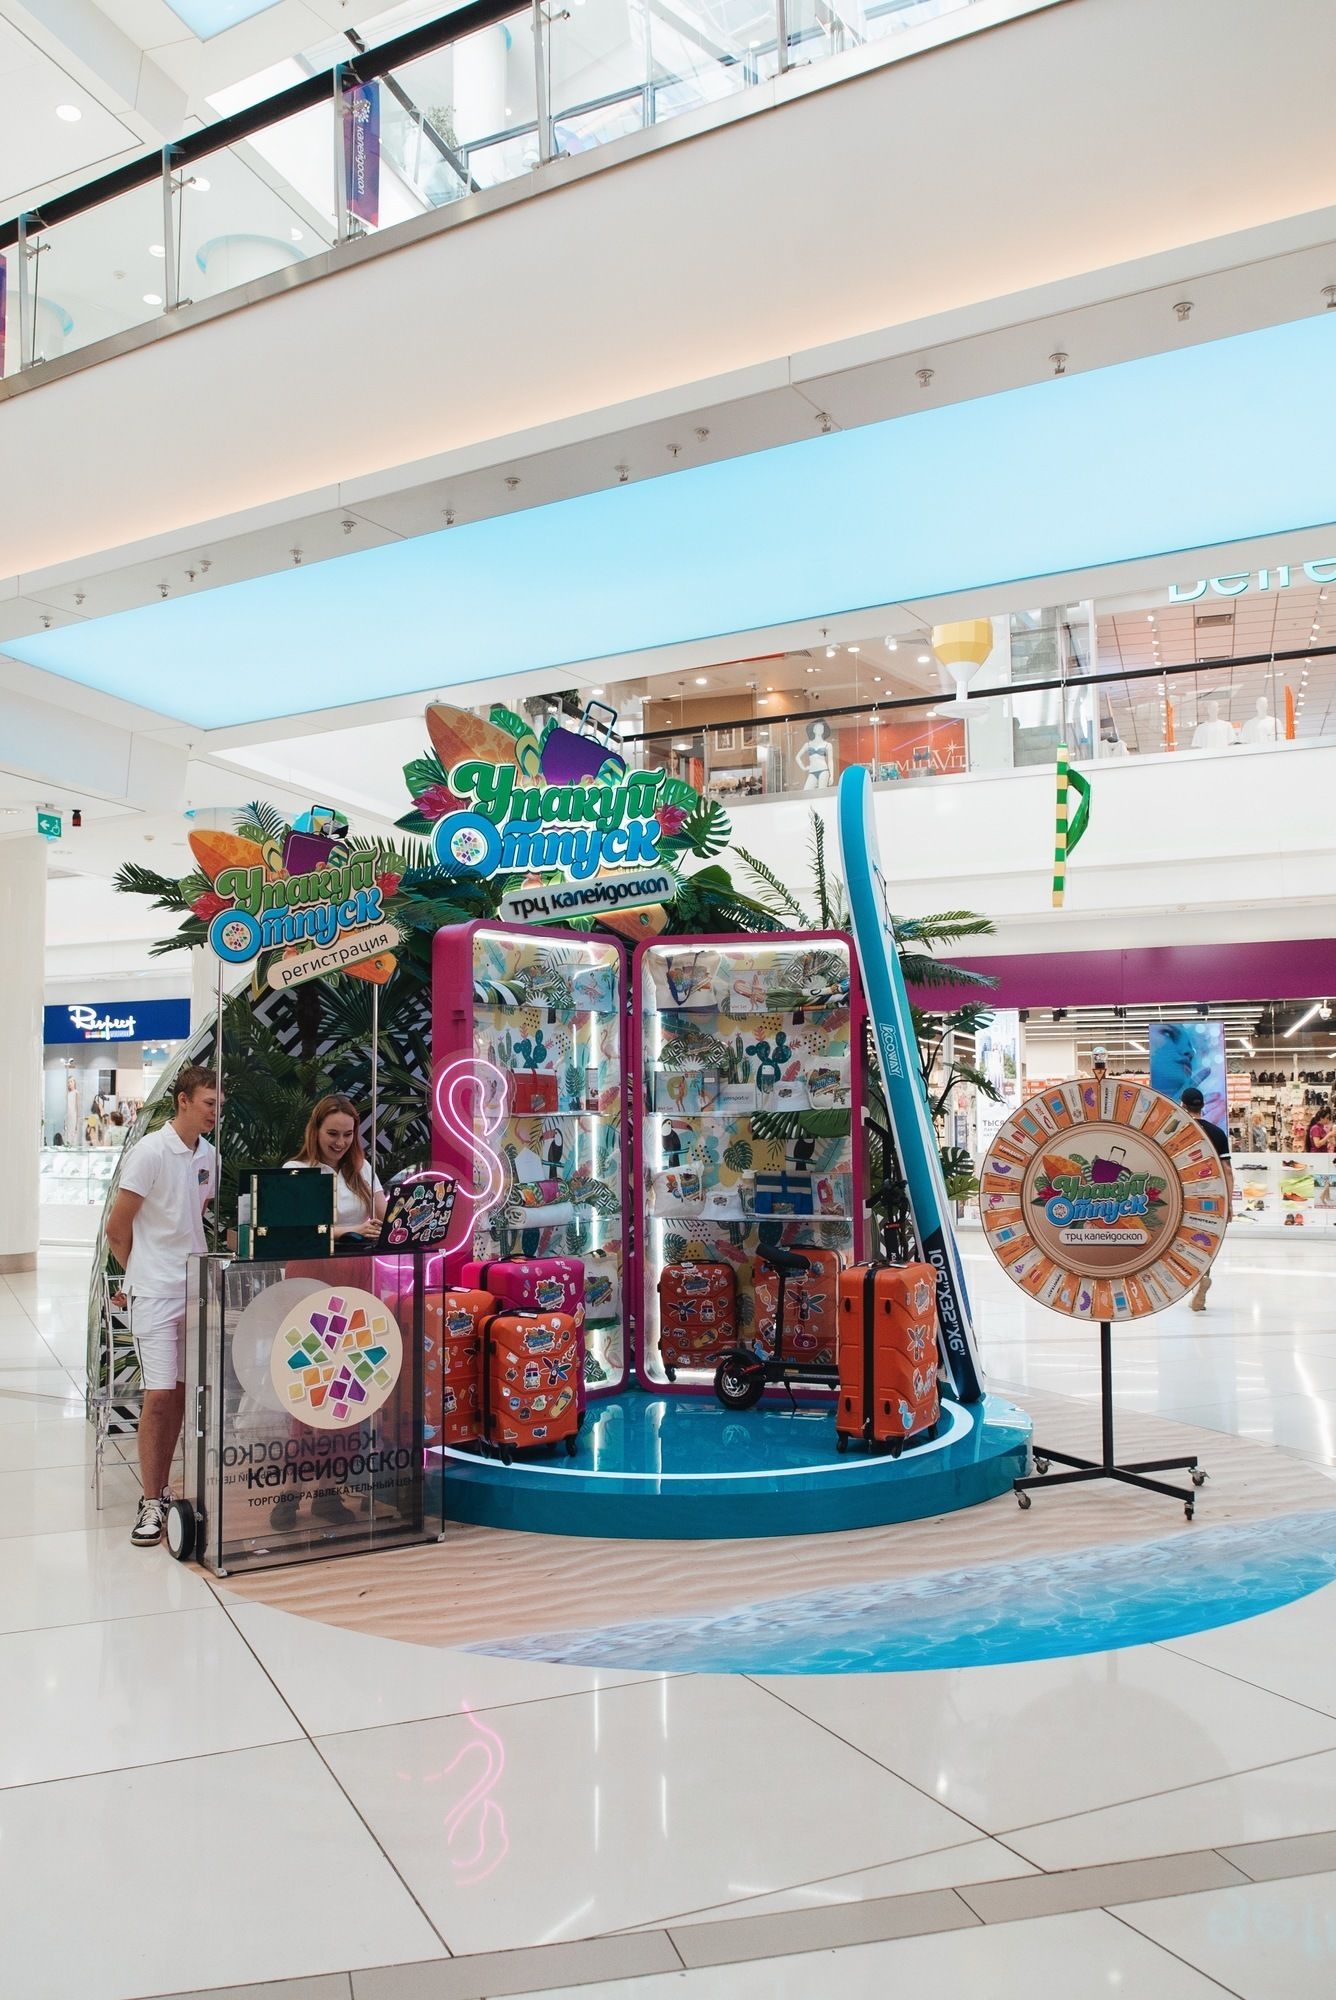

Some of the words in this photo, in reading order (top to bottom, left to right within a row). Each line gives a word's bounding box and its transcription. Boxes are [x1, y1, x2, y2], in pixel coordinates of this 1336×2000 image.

[454, 760, 666, 833] Упакуй
[436, 811, 662, 880] Отпуск
[217, 847, 379, 917] Упакуй
[552, 875, 669, 912] калейдоскоп
[211, 888, 382, 964] Отпуск
[281, 934, 389, 985] регистрация
[1046, 1195, 1148, 1226] Отпуск
[1052, 1173, 1150, 1201] Упакуй
